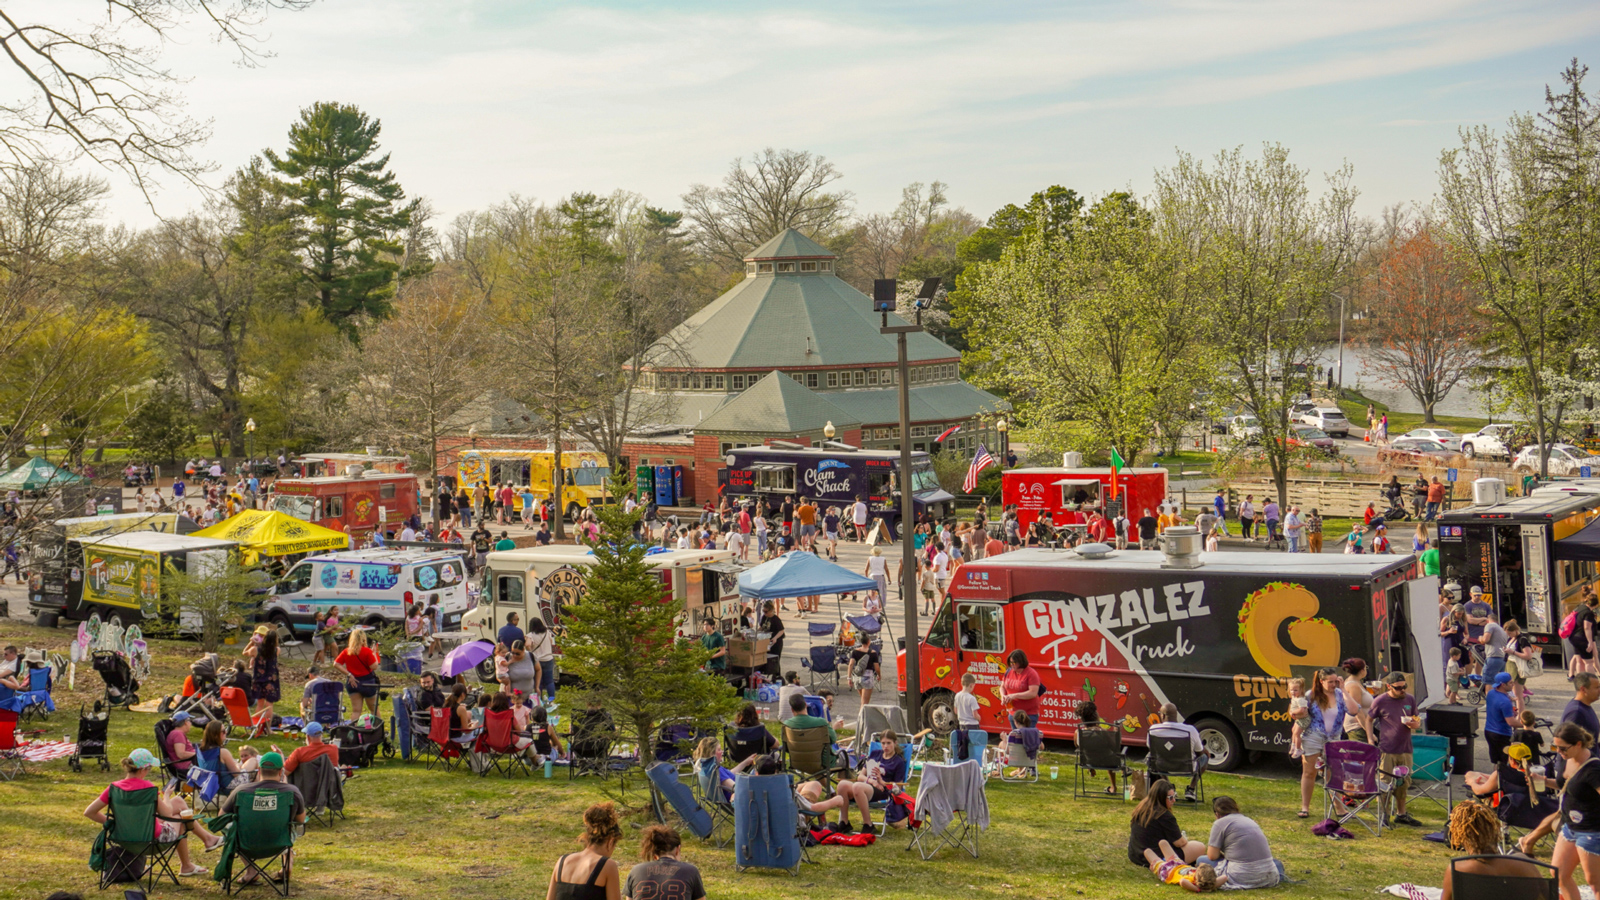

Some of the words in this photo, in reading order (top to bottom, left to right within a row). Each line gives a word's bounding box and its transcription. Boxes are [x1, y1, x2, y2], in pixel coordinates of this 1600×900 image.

[729, 478, 744, 486] HERE
[730, 469, 744, 478] PICK
[804, 468, 836, 487] Clam
[815, 478, 851, 498] Shack
[273, 536, 344, 554] TRINITYBREWHOUSE.COM
[91, 559, 135, 590] TRINITY
[545, 573, 562, 595] BIG
[565, 572, 588, 596] DOG
[1023, 580, 1211, 639] GONZALEZ
[1040, 635, 1108, 678] Food
[1119, 623, 1196, 671] Truck
[1241, 697, 1292, 726] Food
[254, 799, 275, 808] DICKS
[634, 879, 686, 900] 28
